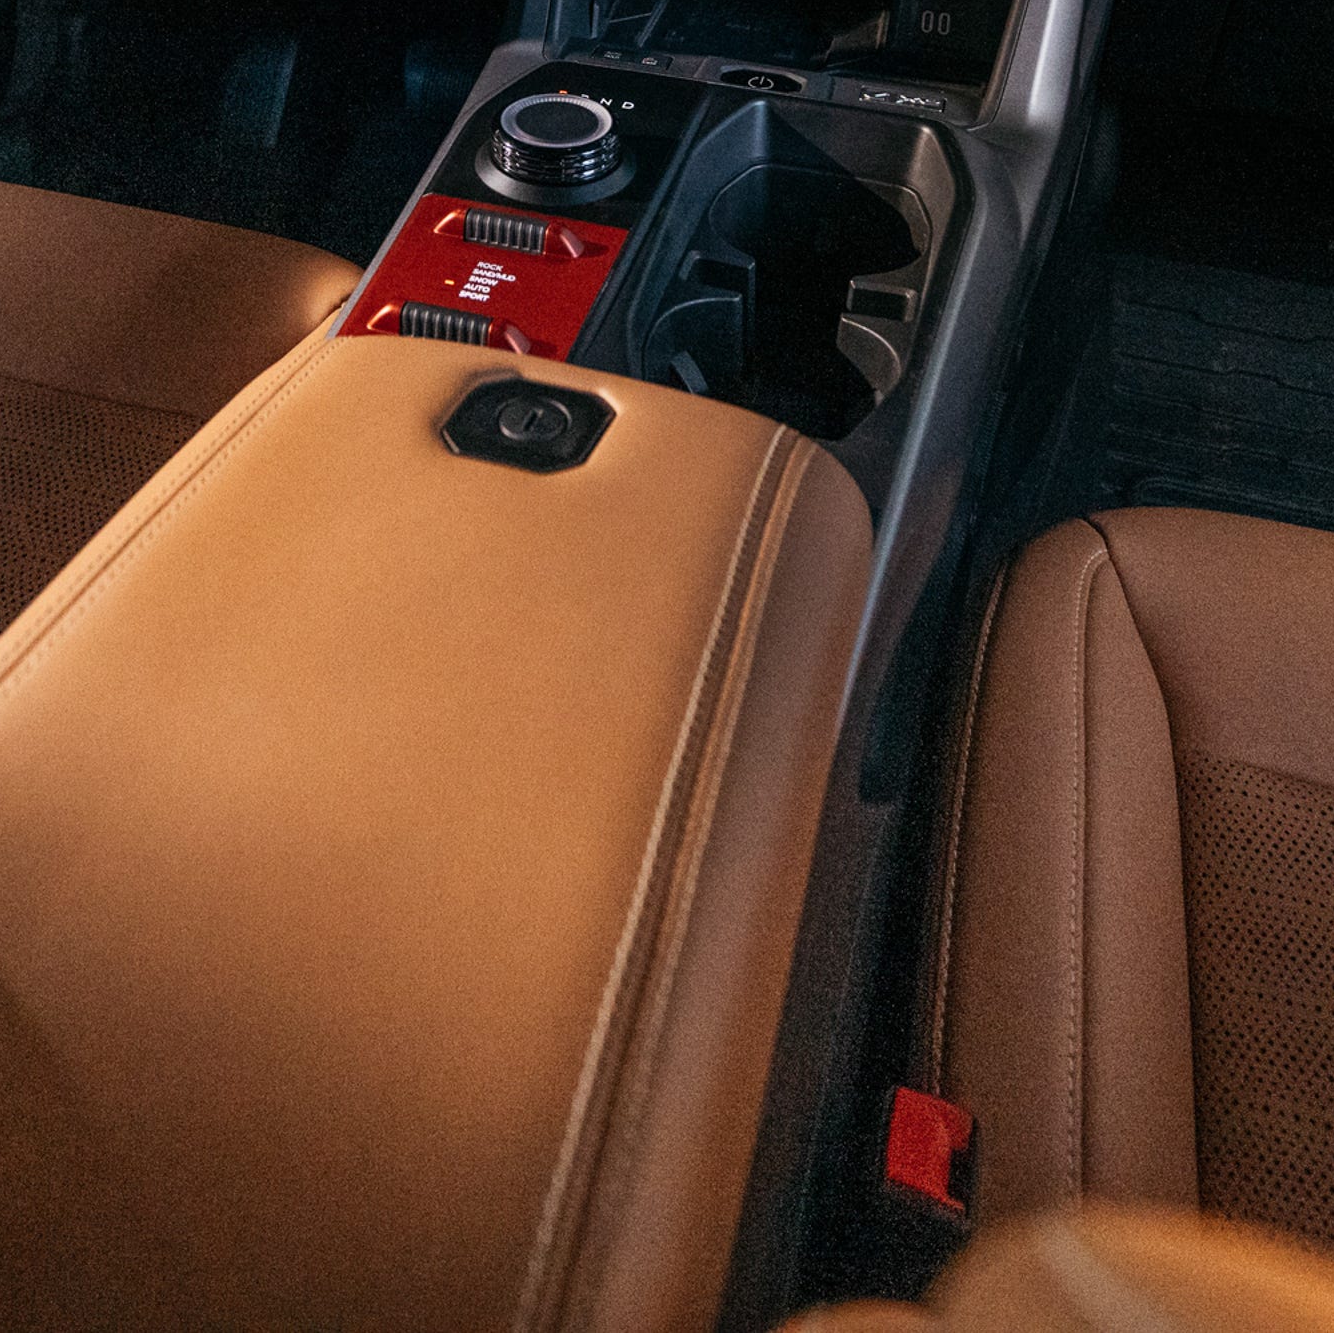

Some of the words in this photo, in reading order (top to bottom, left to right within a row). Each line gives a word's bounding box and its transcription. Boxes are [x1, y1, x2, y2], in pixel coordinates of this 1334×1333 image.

[600, 98, 613, 106] N
[621, 101, 635, 109] D
[477, 261, 504, 272] ROCK
[468, 275, 499, 286] SNOW
[463, 283, 491, 293] AUTO
[458, 290, 490, 302] SPORT
